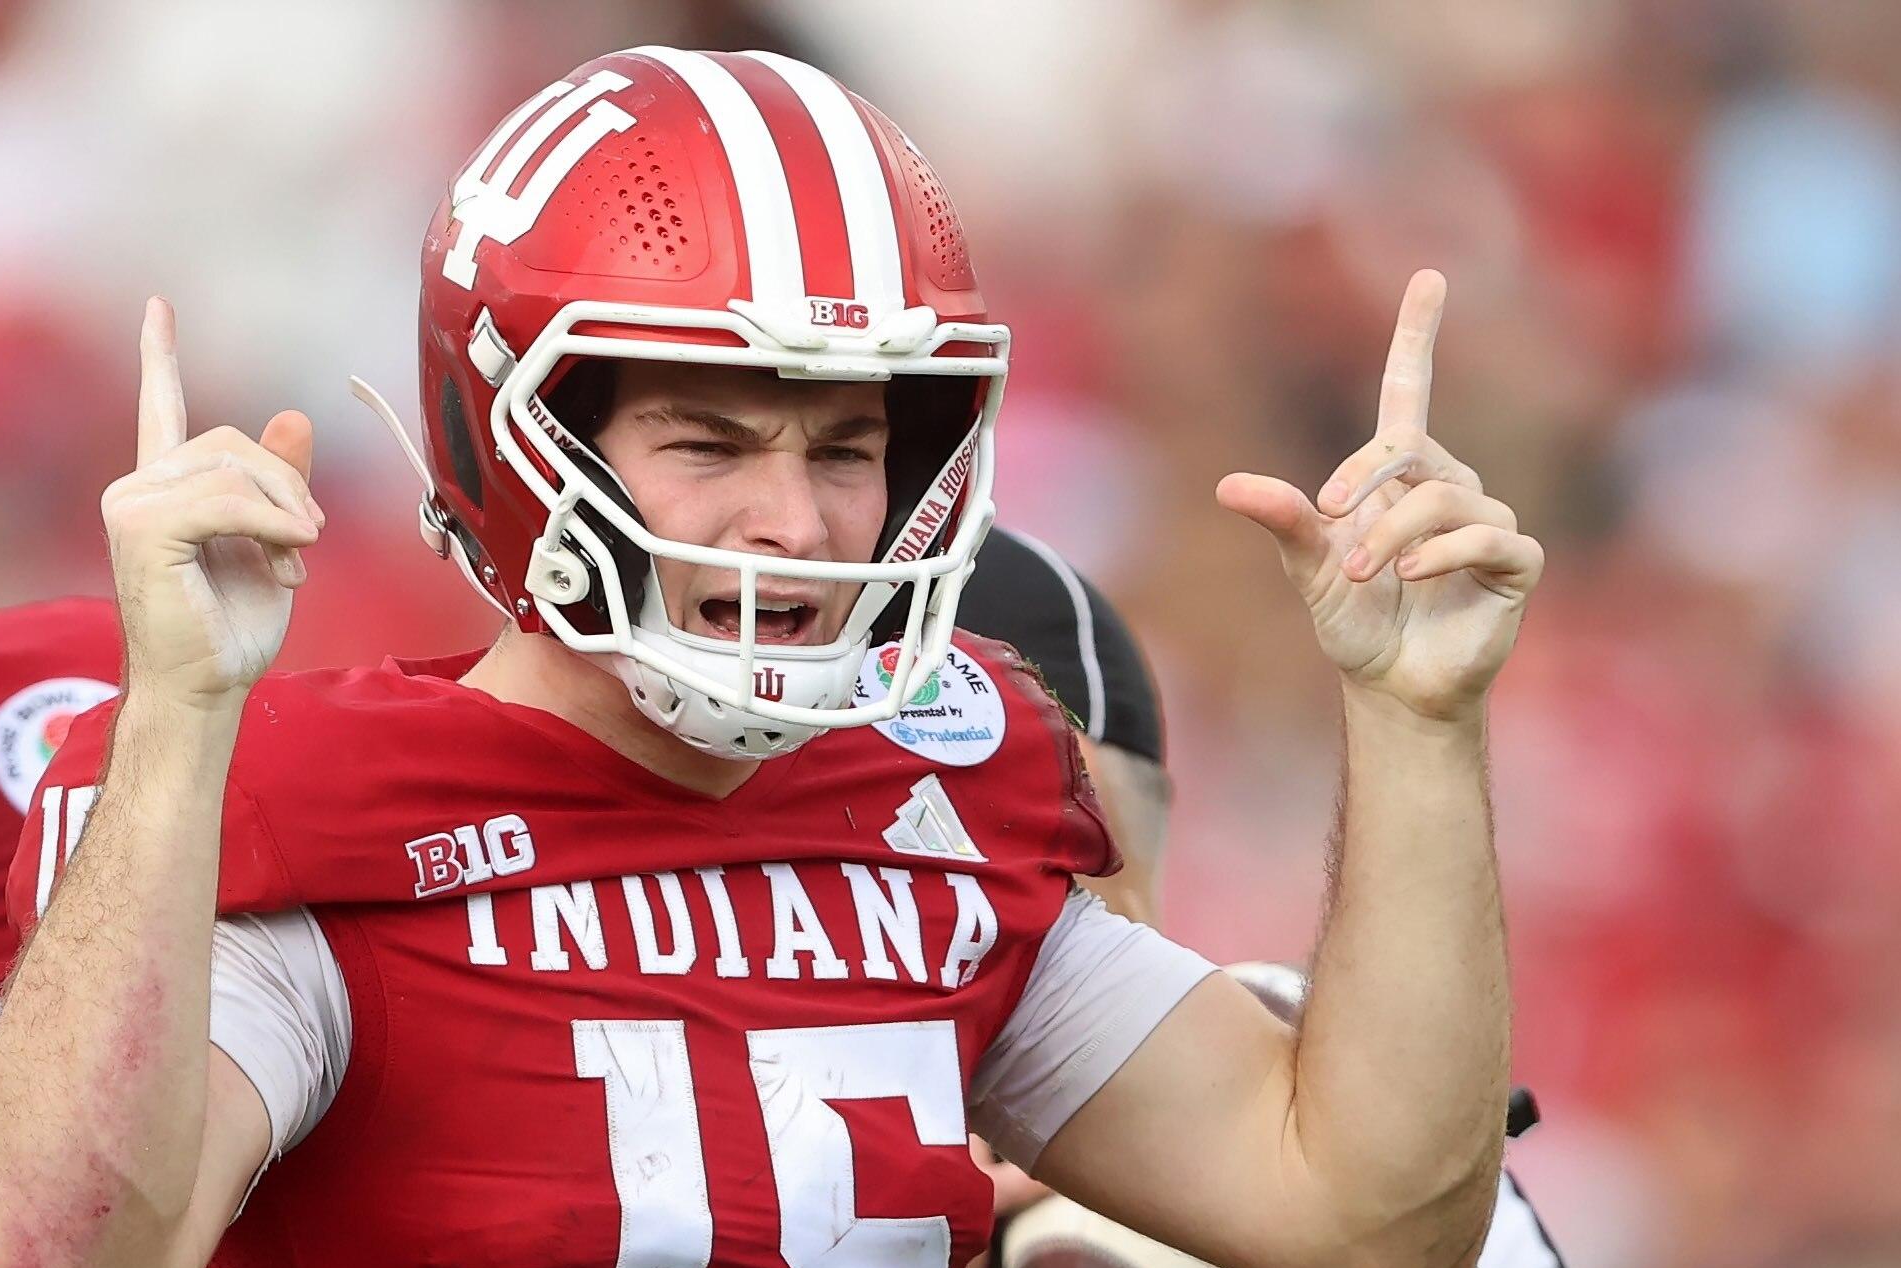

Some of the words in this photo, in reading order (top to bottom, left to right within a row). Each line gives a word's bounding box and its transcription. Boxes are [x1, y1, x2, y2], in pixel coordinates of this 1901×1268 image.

[947, 652, 989, 695] AME
[914, 725, 994, 742] Prudential
[466, 862, 999, 988] INDIANA
